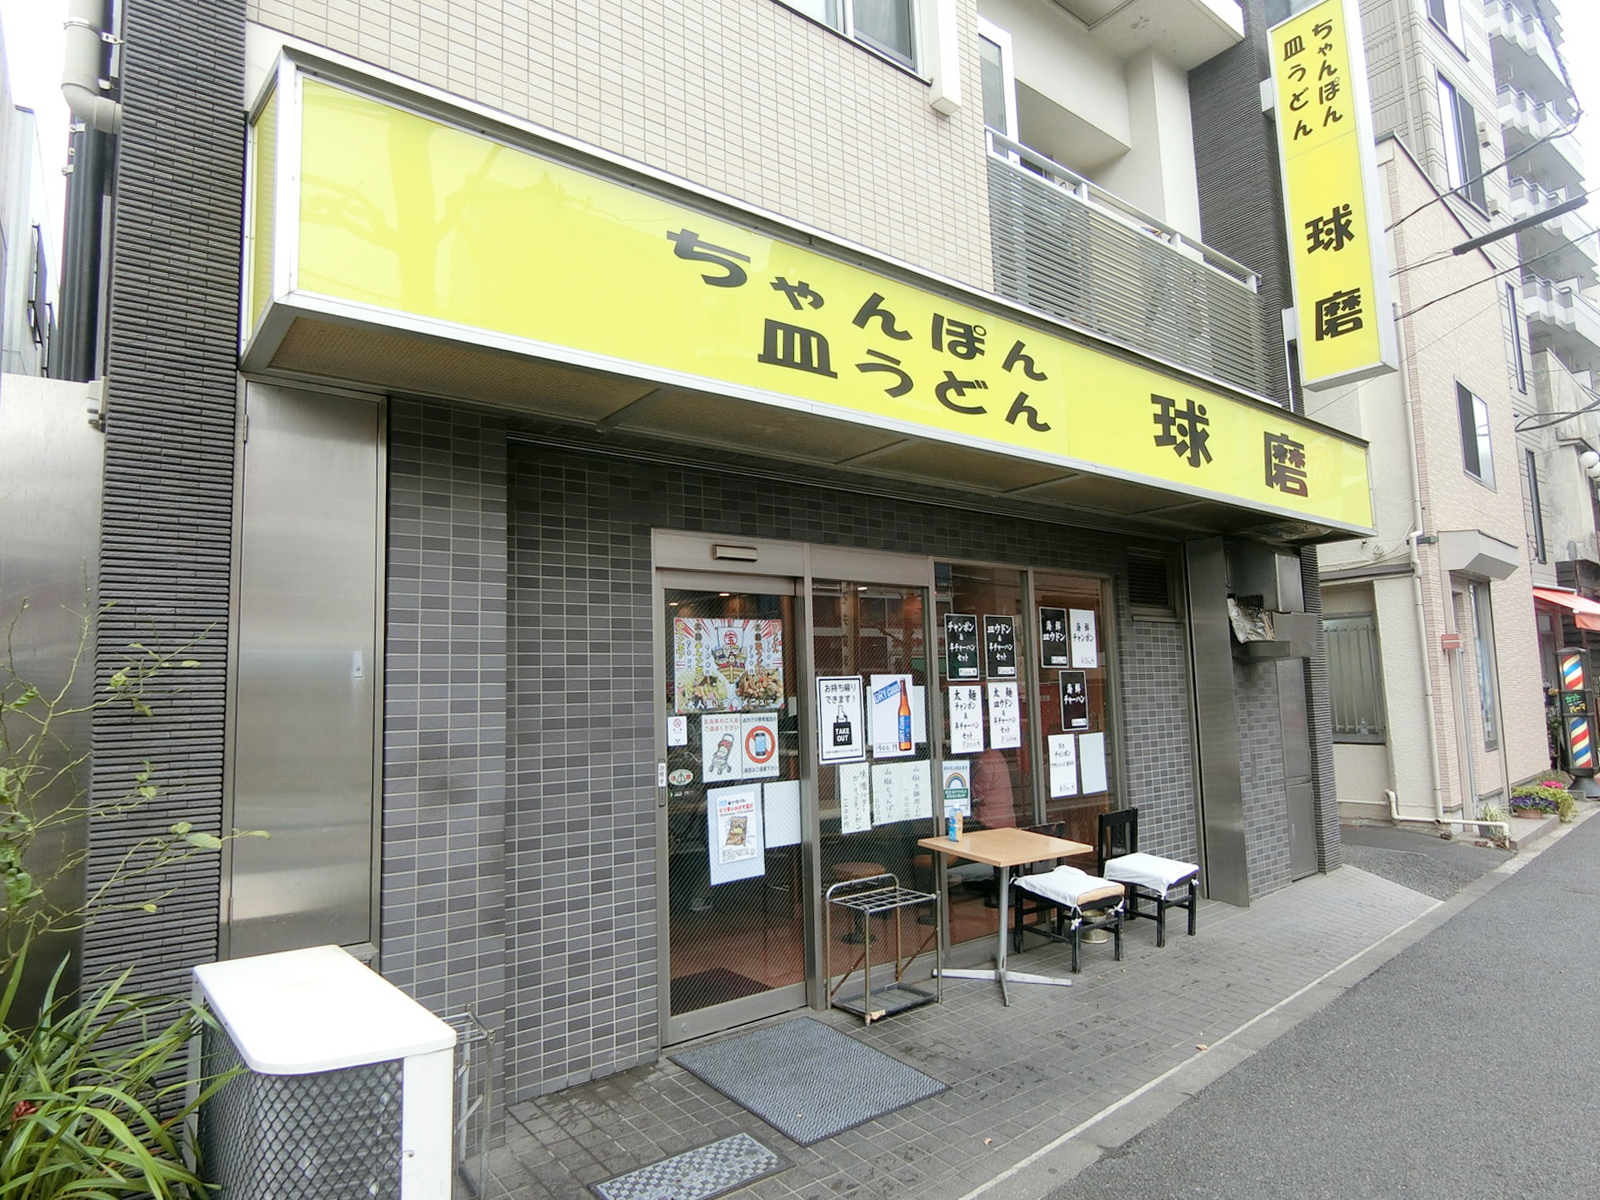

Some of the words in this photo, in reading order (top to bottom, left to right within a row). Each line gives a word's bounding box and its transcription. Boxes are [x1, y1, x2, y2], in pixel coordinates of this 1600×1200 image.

[1311, 19, 1343, 128] ちゃんぽん
[1283, 35, 1313, 140] 皿うどん
[1304, 204, 1363, 341] 球磨
[667, 228, 1048, 382] ちゃんぽん
[758, 318, 1051, 432] 皿うどん
[1151, 393, 1309, 497] 球磨
[948, 621, 974, 633] チャンポン
[987, 623, 1012, 634] 皿ウドン
[725, 631, 737, 645] 宝
[1042, 632, 1066, 642] 皿ウドン
[1073, 633, 1094, 642] チャンポン
[957, 653, 969, 662] セット
[996, 652, 1007, 661] セット
[824, 684, 856, 693] お持ち帰り
[1064, 695, 1085, 705] チャーハン
[1564, 693, 1581, 703] カット
[955, 701, 976, 711] チャンポン
[994, 699, 1013, 709] 皿ウドン
[1569, 703, 1587, 713] パーマ
[835, 727, 850, 735] TAKE
